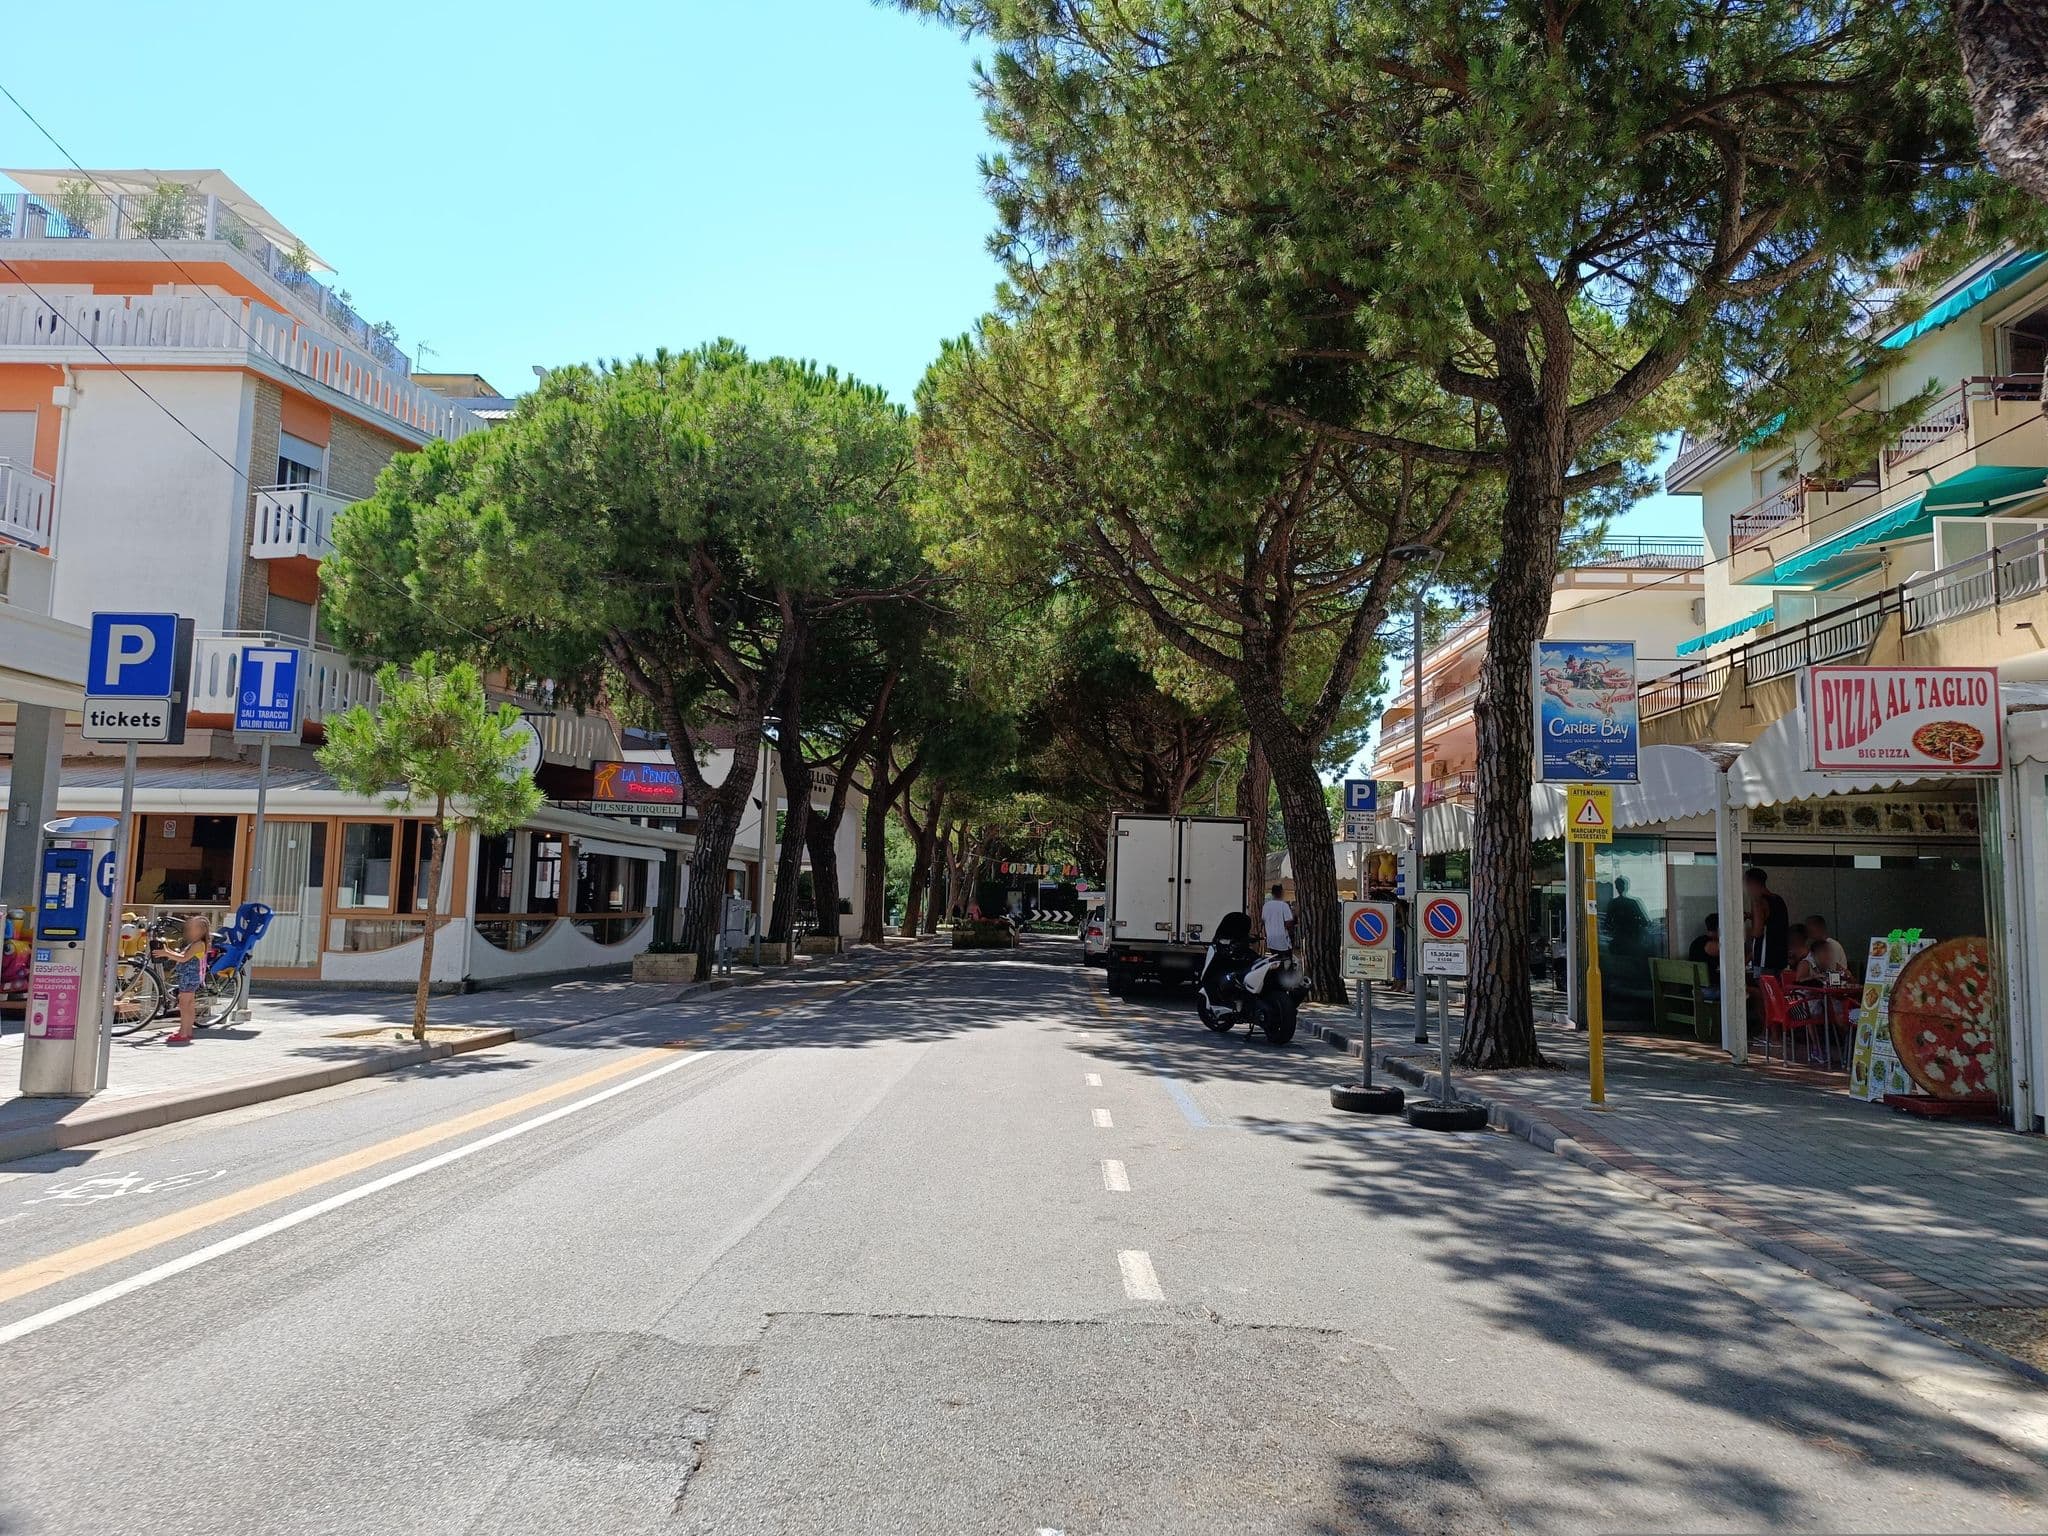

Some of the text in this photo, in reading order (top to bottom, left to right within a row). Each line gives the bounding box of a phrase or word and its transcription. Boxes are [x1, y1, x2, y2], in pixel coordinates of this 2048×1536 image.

[105, 624, 156, 685] P
[248, 650, 292, 707] T
[90, 711, 162, 727] tickets
[241, 709, 289, 719] SALI TABACCHI
[1821, 677, 1988, 750] PIZZA AL TAGLIO
[240, 719, 289, 729] VALORI BOLLATI
[1858, 748, 1910, 759] BIG PIZZA
[621, 769, 636, 782] LA
[1352, 784, 1370, 806] P
[594, 804, 679, 815] PILSNER URQUELL
